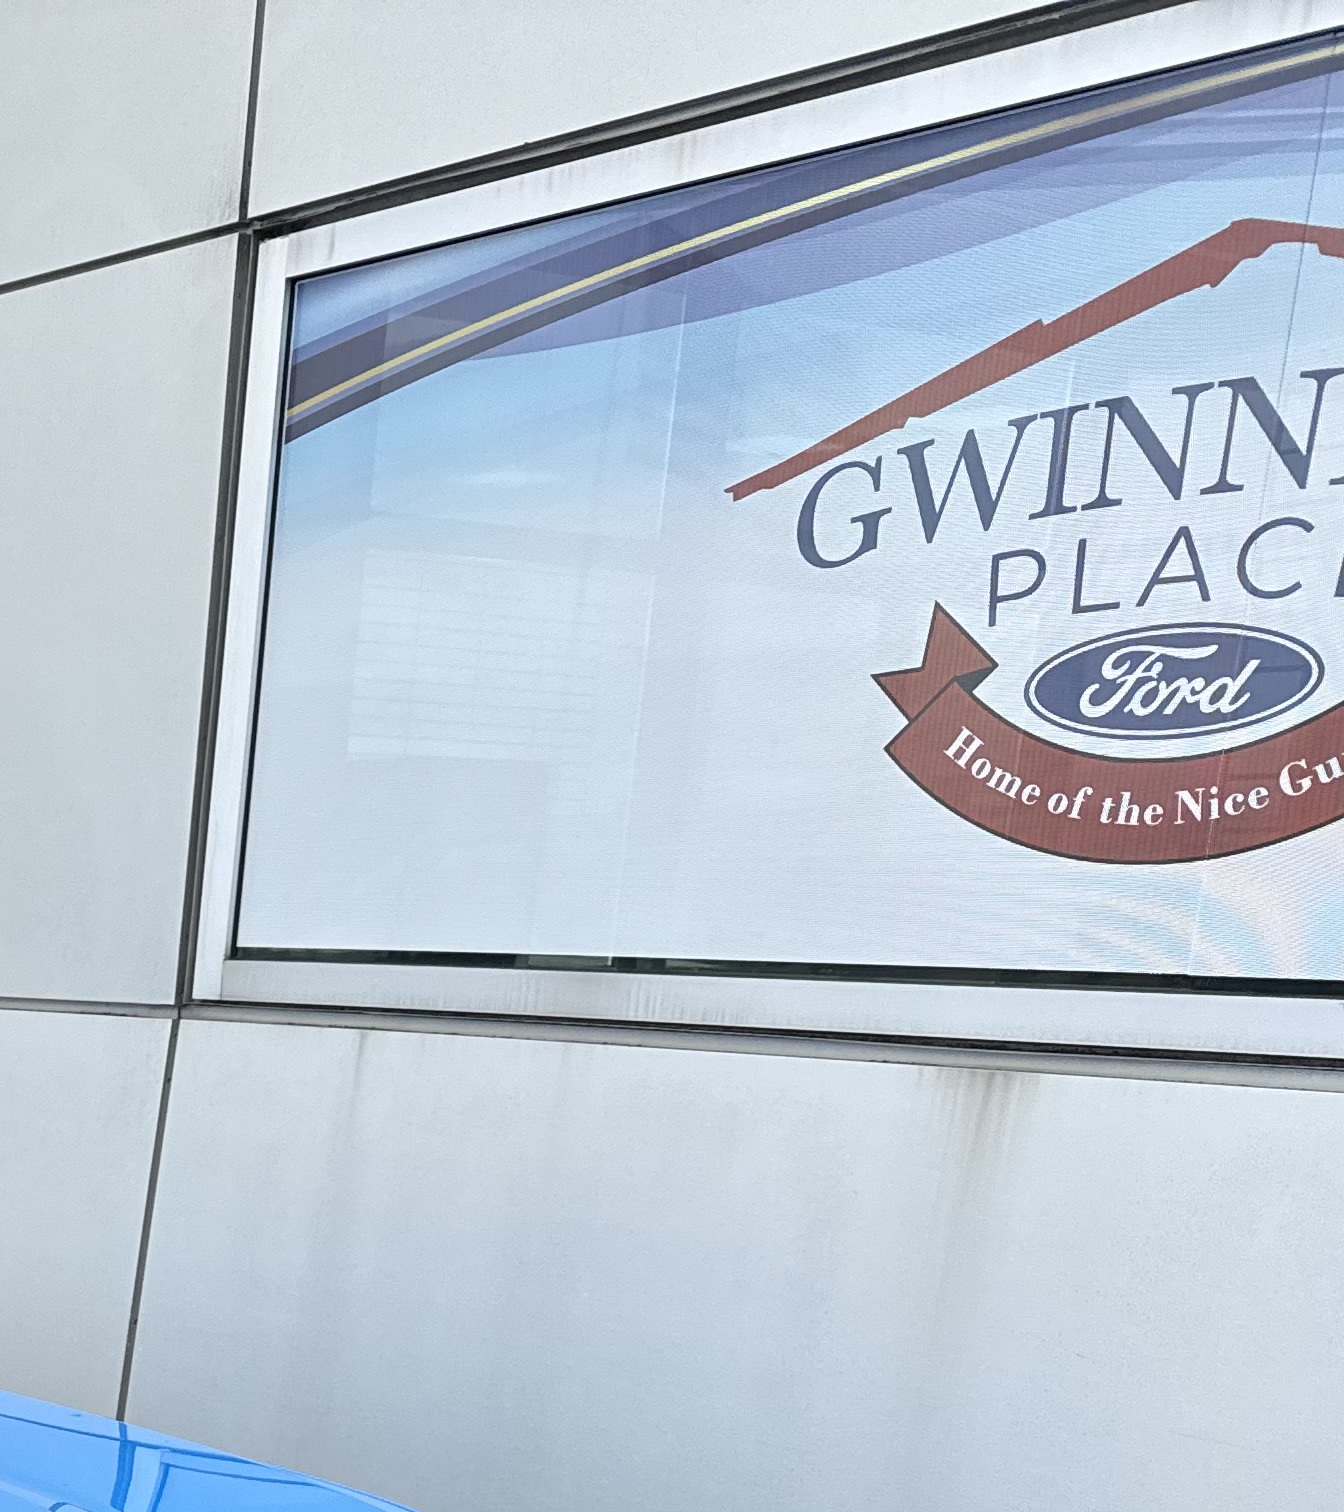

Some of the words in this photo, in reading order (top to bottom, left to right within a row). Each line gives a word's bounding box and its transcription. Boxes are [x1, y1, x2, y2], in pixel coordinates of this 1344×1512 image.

[796, 367, 1344, 568] GWINN
[988, 517, 1344, 627] PLAC
[1079, 644, 1261, 718] Ford
[942, 725, 1042, 806] Home
[1047, 786, 1094, 820] of
[1098, 791, 1164, 826] the
[1174, 785, 1270, 825] Nice
[1279, 752, 1344, 797] Gu
